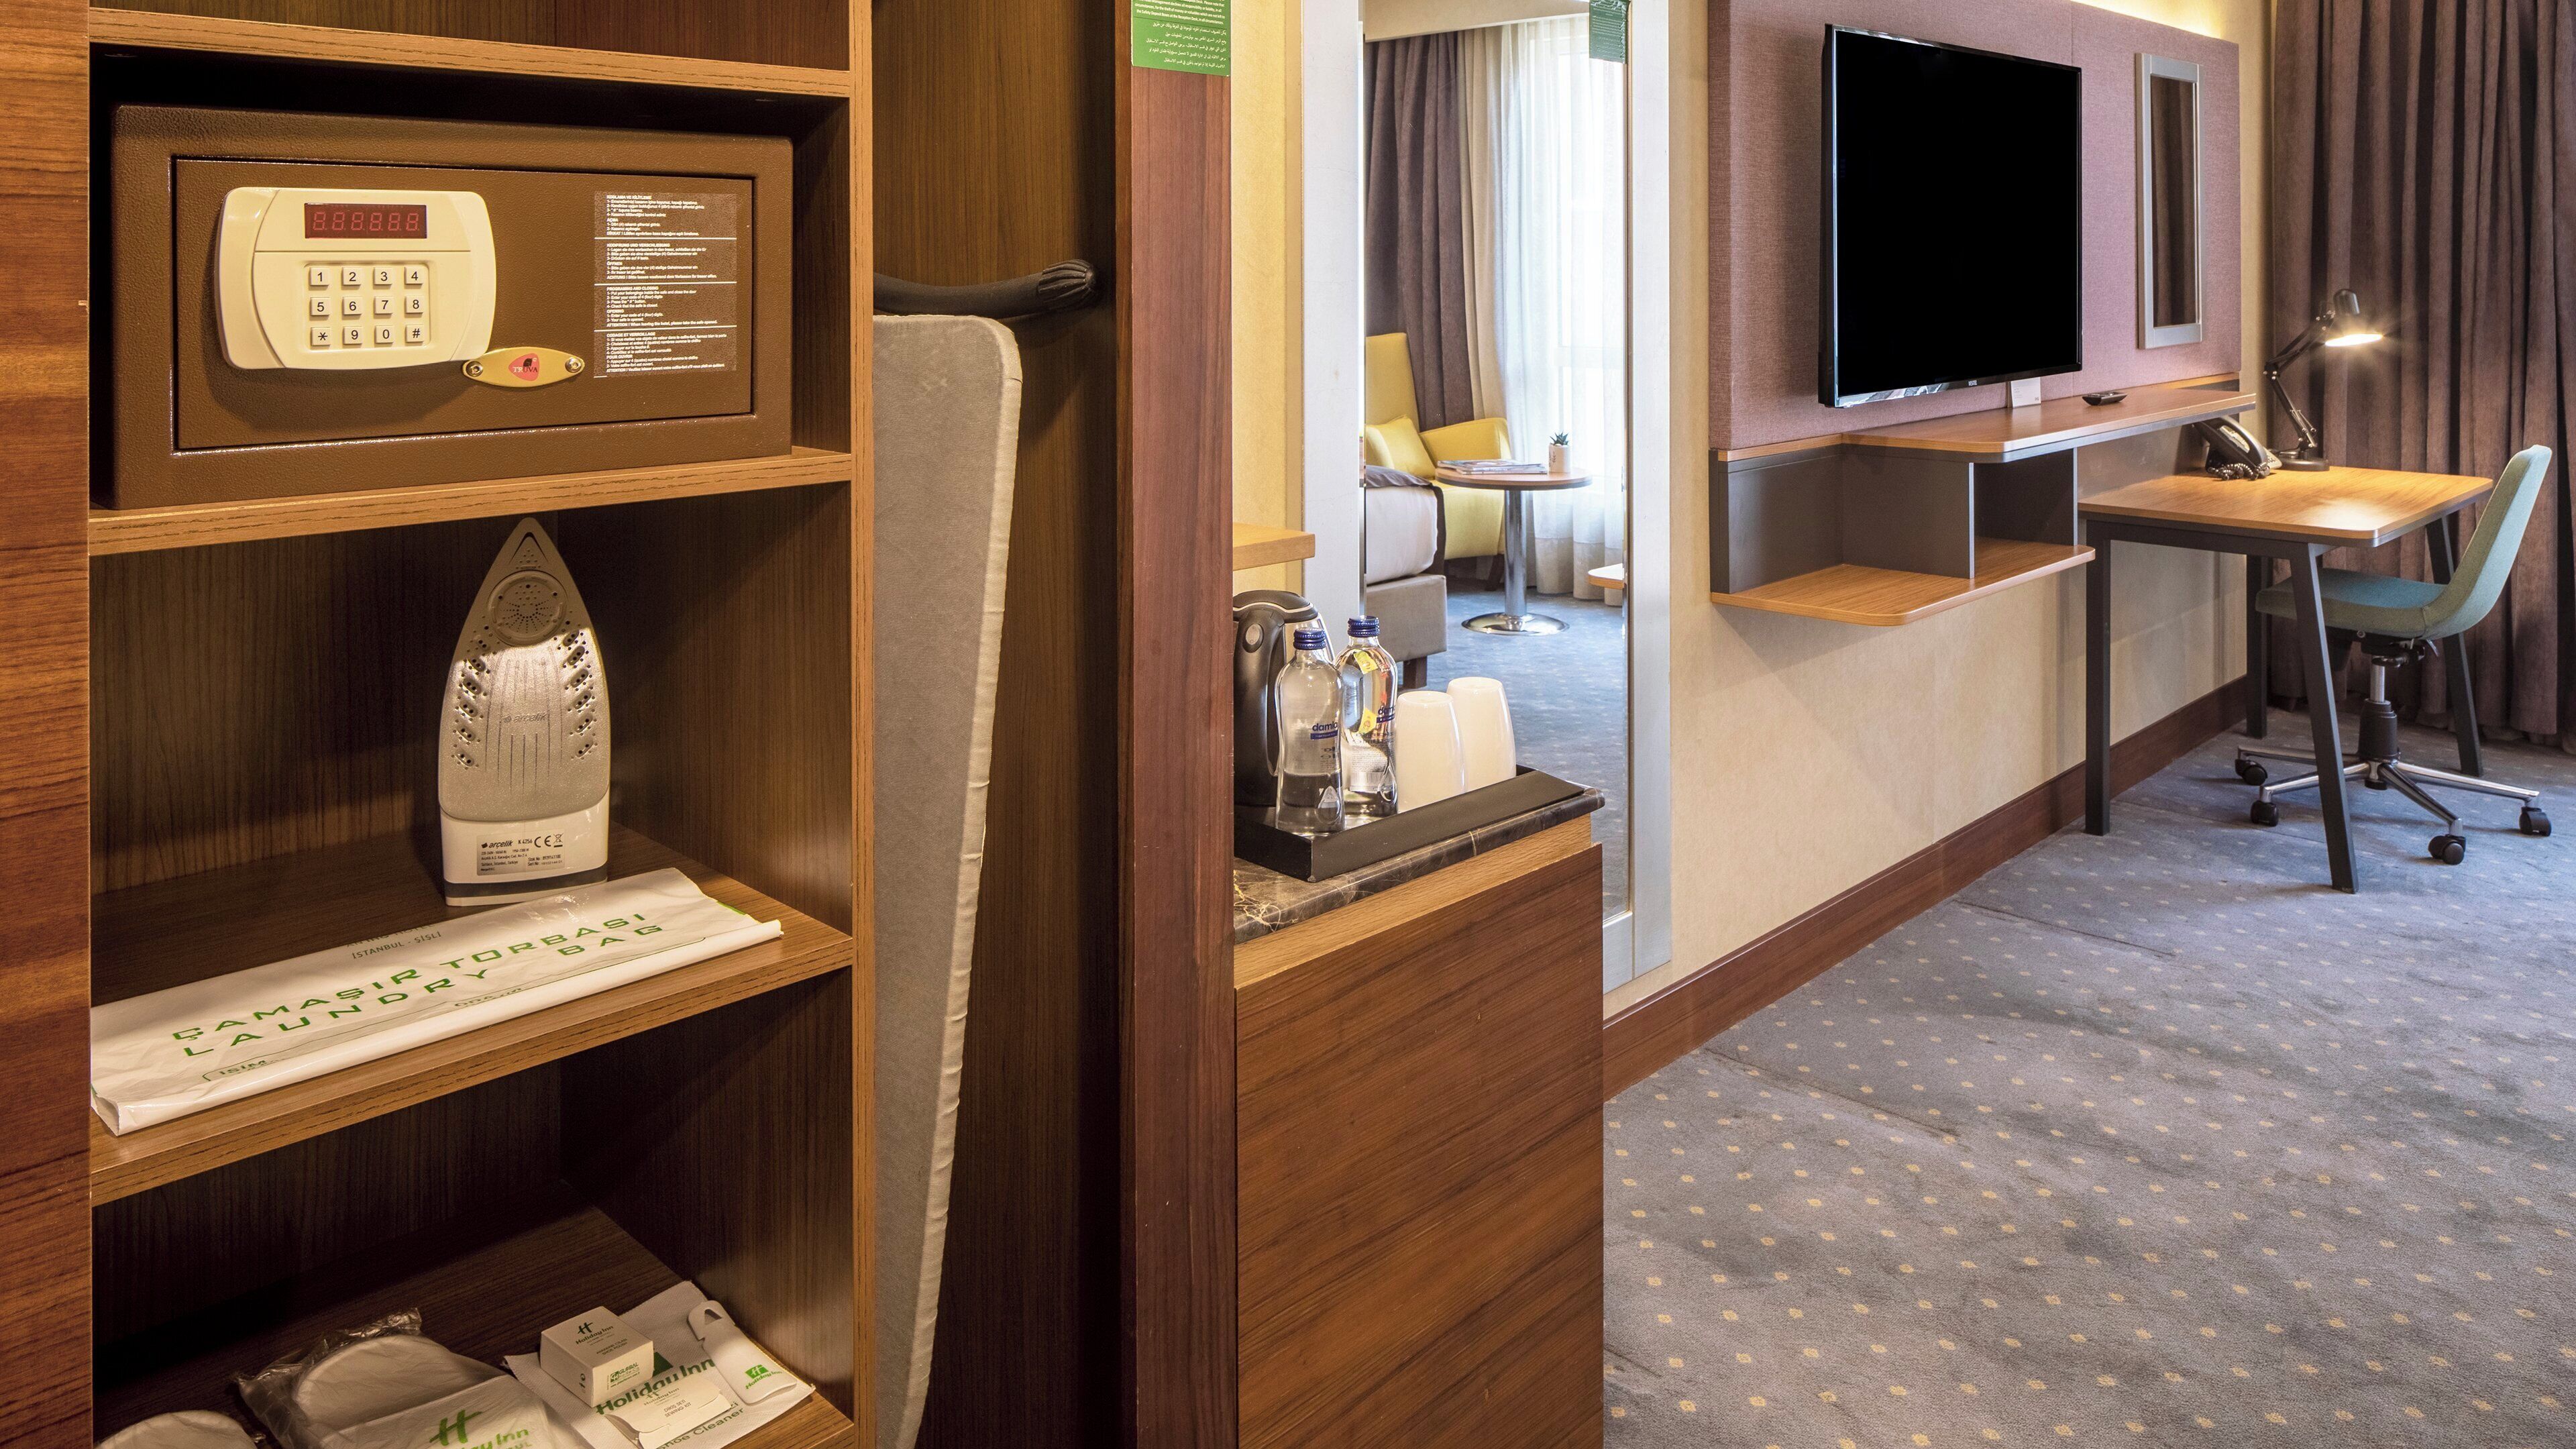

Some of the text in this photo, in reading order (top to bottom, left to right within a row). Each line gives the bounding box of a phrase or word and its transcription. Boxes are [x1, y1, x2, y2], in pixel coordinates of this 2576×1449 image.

[318, 271, 419, 282] 1 2 3 4
[317, 299, 419, 312] 5 6 7 8
[351, 328, 420, 340] 9 0 #
[489, 840, 513, 849] arçelik
[352, 942, 405, 959] İSTANBUL
[414, 930, 442, 943] ŞİŞLİ
[172, 913, 645, 1041] ÇAMAŞIR TORBASI
[183, 925, 663, 1057] LAUNDRY BAG
[576, 1331, 602, 1344] Holiday
[596, 1374, 678, 1415] Holiday
[681, 1359, 715, 1377] Inn
[745, 1373, 772, 1389] Holiday
[644, 1393, 669, 1405] Holiday
[693, 1408, 744, 1435] Cleaner
[496, 1429, 529, 1445] Inn
